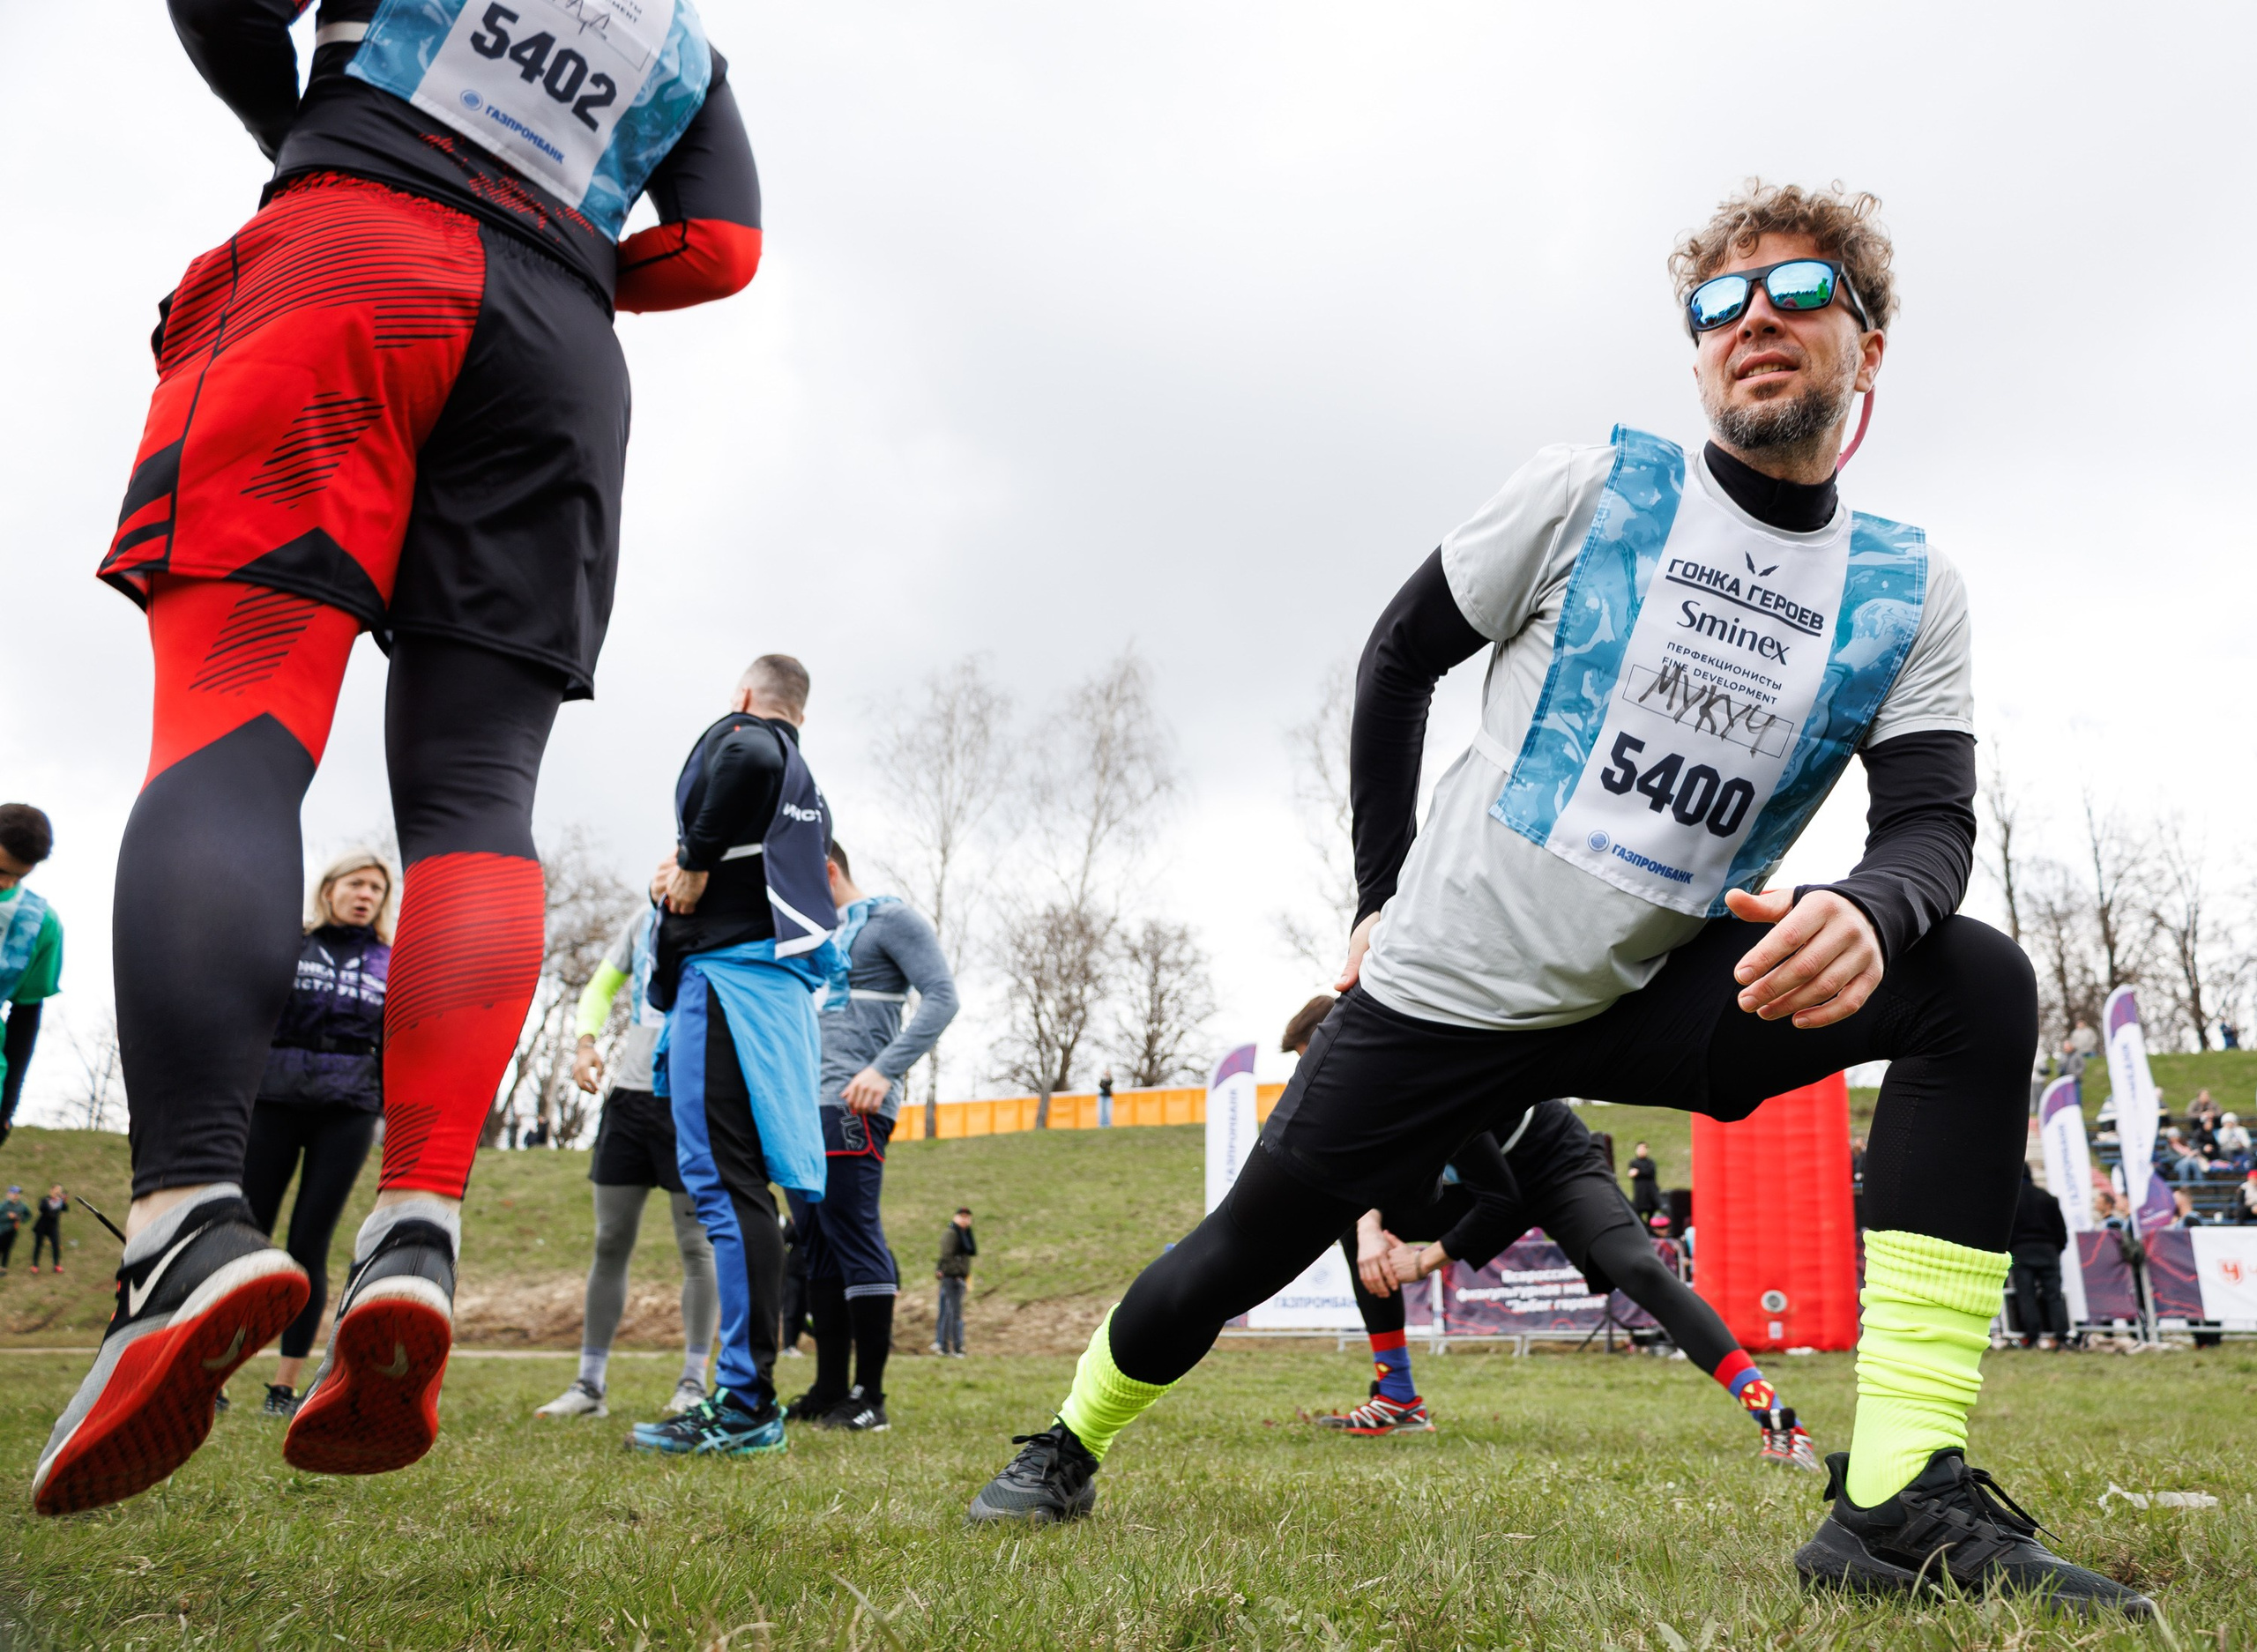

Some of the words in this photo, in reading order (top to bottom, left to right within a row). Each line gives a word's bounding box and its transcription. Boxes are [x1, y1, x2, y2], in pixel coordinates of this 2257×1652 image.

[469, 1, 617, 132] 5402
[485, 105, 565, 165] ГАЗПРОМБАНК
[1667, 558, 1740, 597] ГОНКА
[1747, 584, 1825, 631] ГЕРОЕВ
[1676, 599, 1791, 666] Sminex
[1661, 656, 1689, 673] FINE
[1693, 667, 1778, 705] DEVELOPMENT
[1666, 641, 1783, 691] ПЕРФЕКЦИОНИСТЫ
[1600, 730, 1755, 838] 5400
[1612, 844, 1695, 884] ГАЗПРОМБАНК
